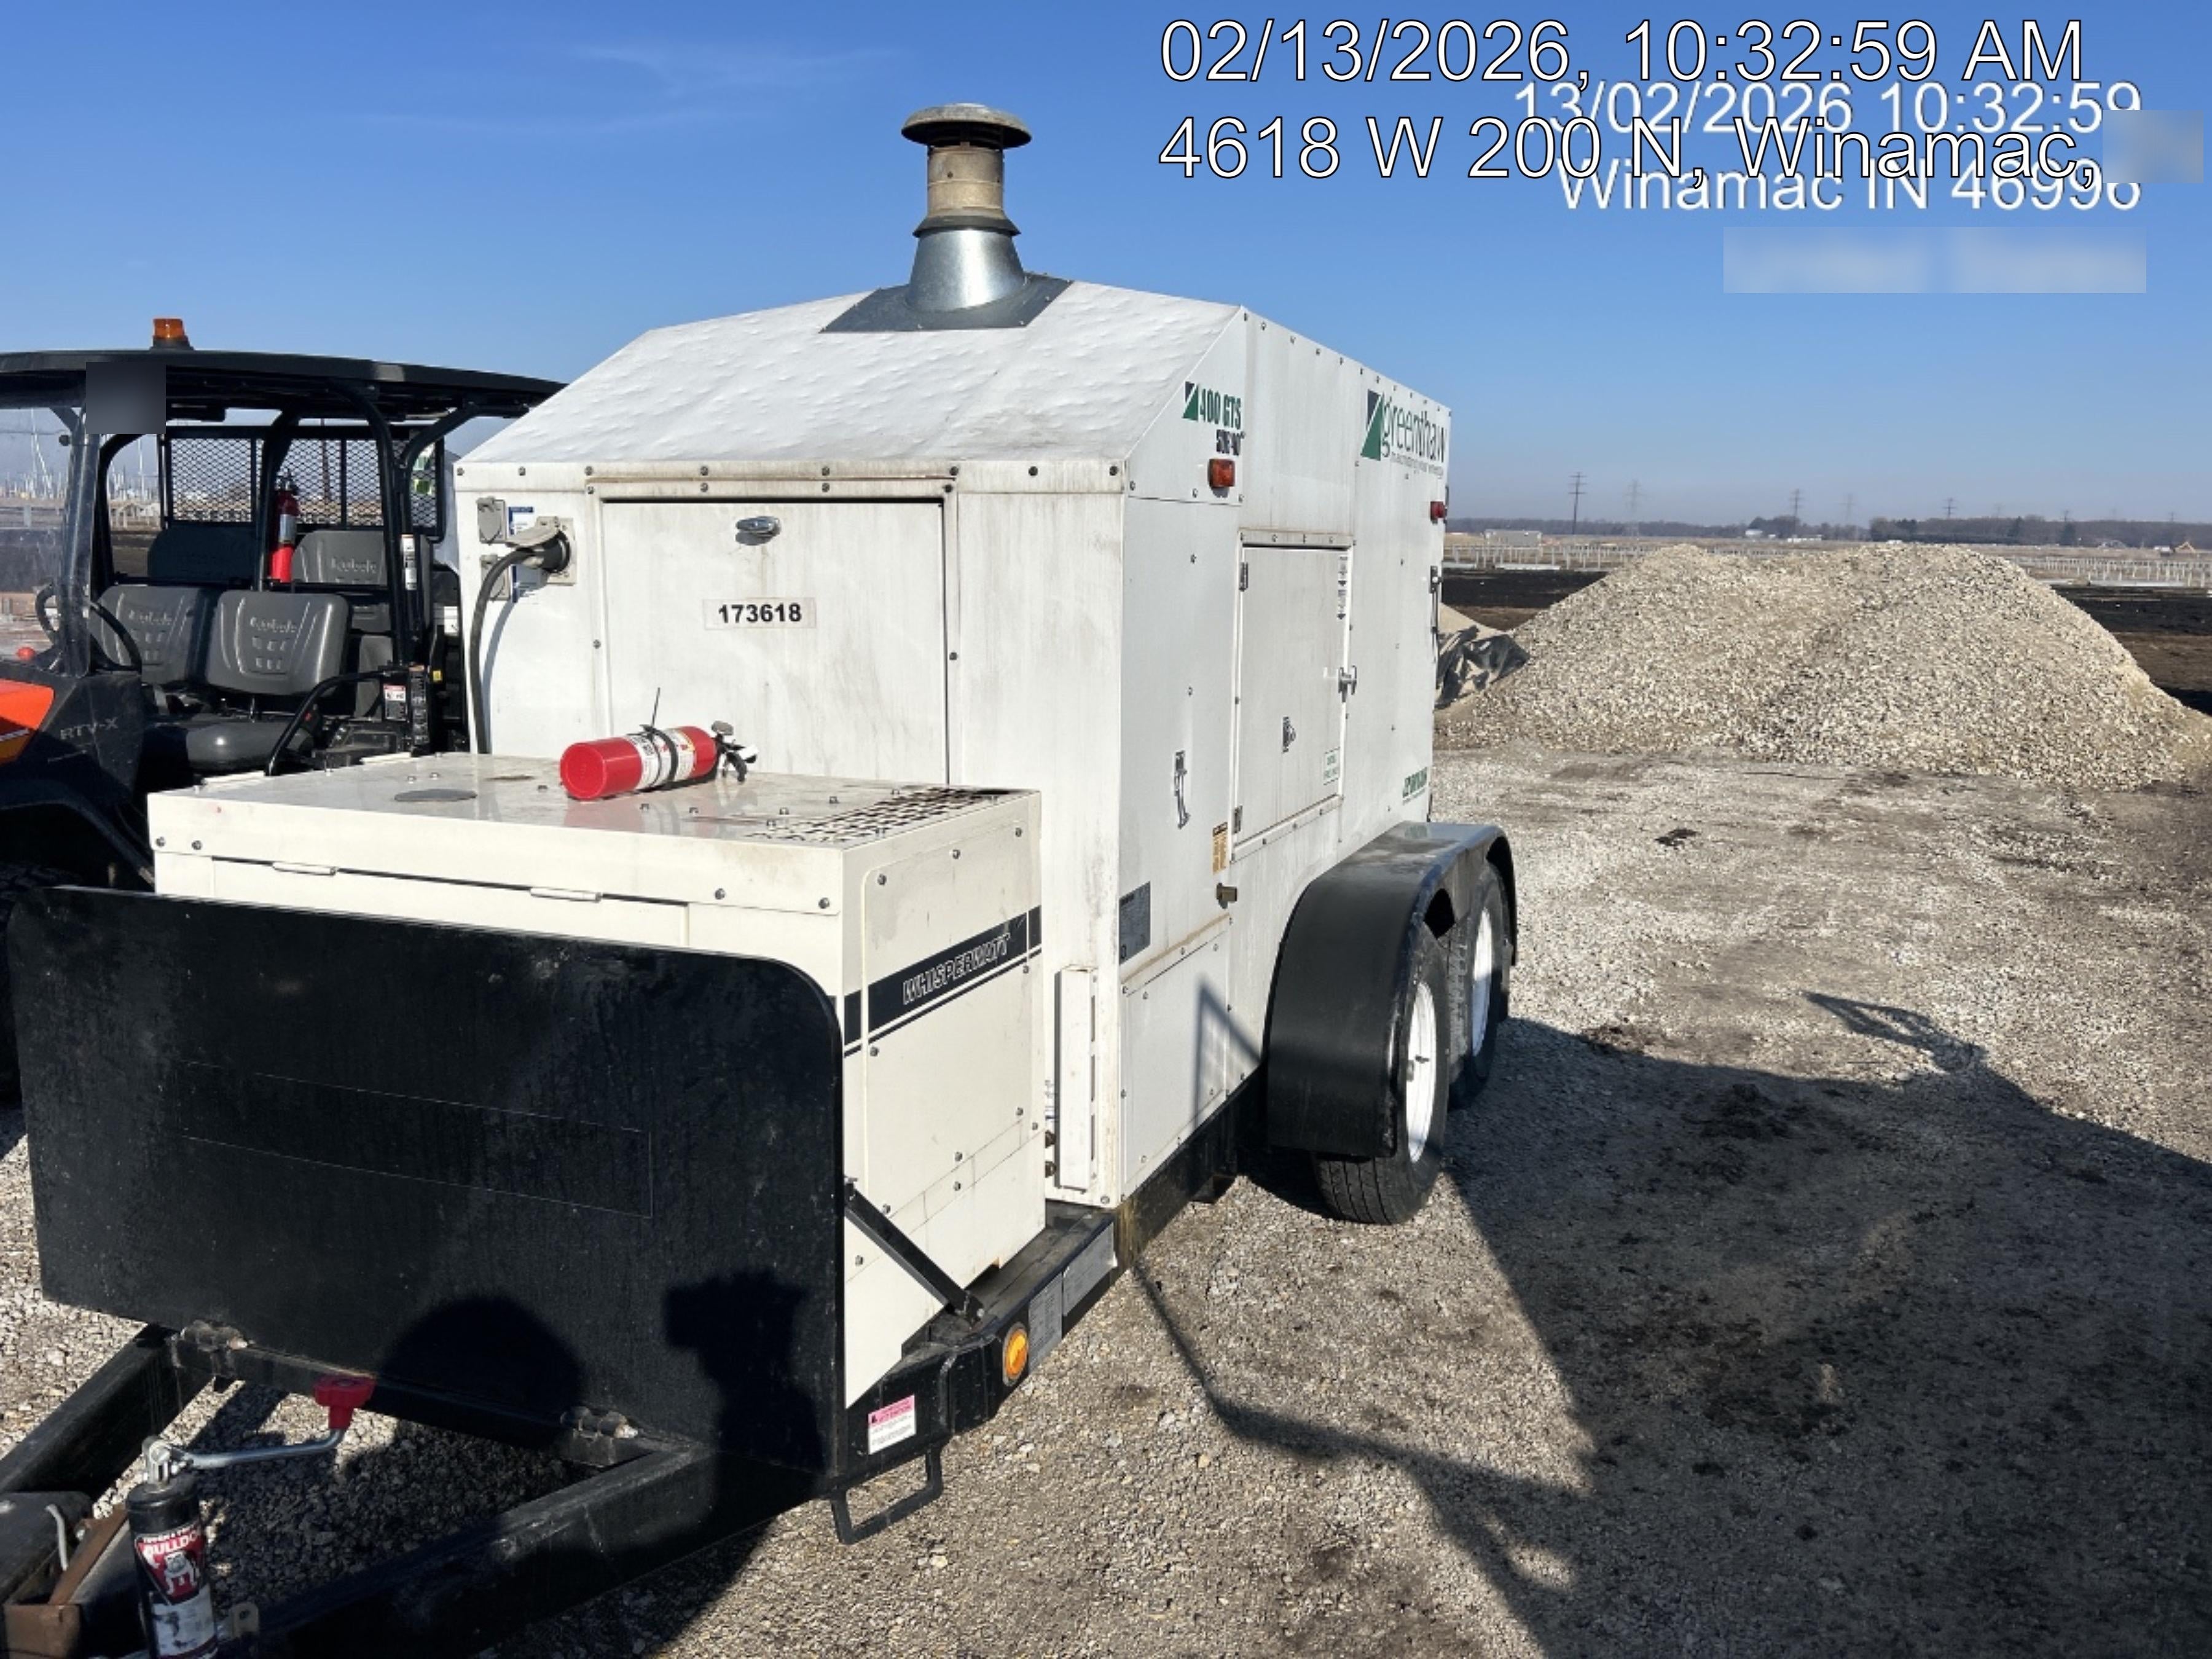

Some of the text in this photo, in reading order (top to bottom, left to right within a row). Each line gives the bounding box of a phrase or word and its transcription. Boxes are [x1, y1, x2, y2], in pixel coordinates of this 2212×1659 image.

[1199, 387, 1241, 430] 400 GTS
[718, 602, 802, 624] 173618
